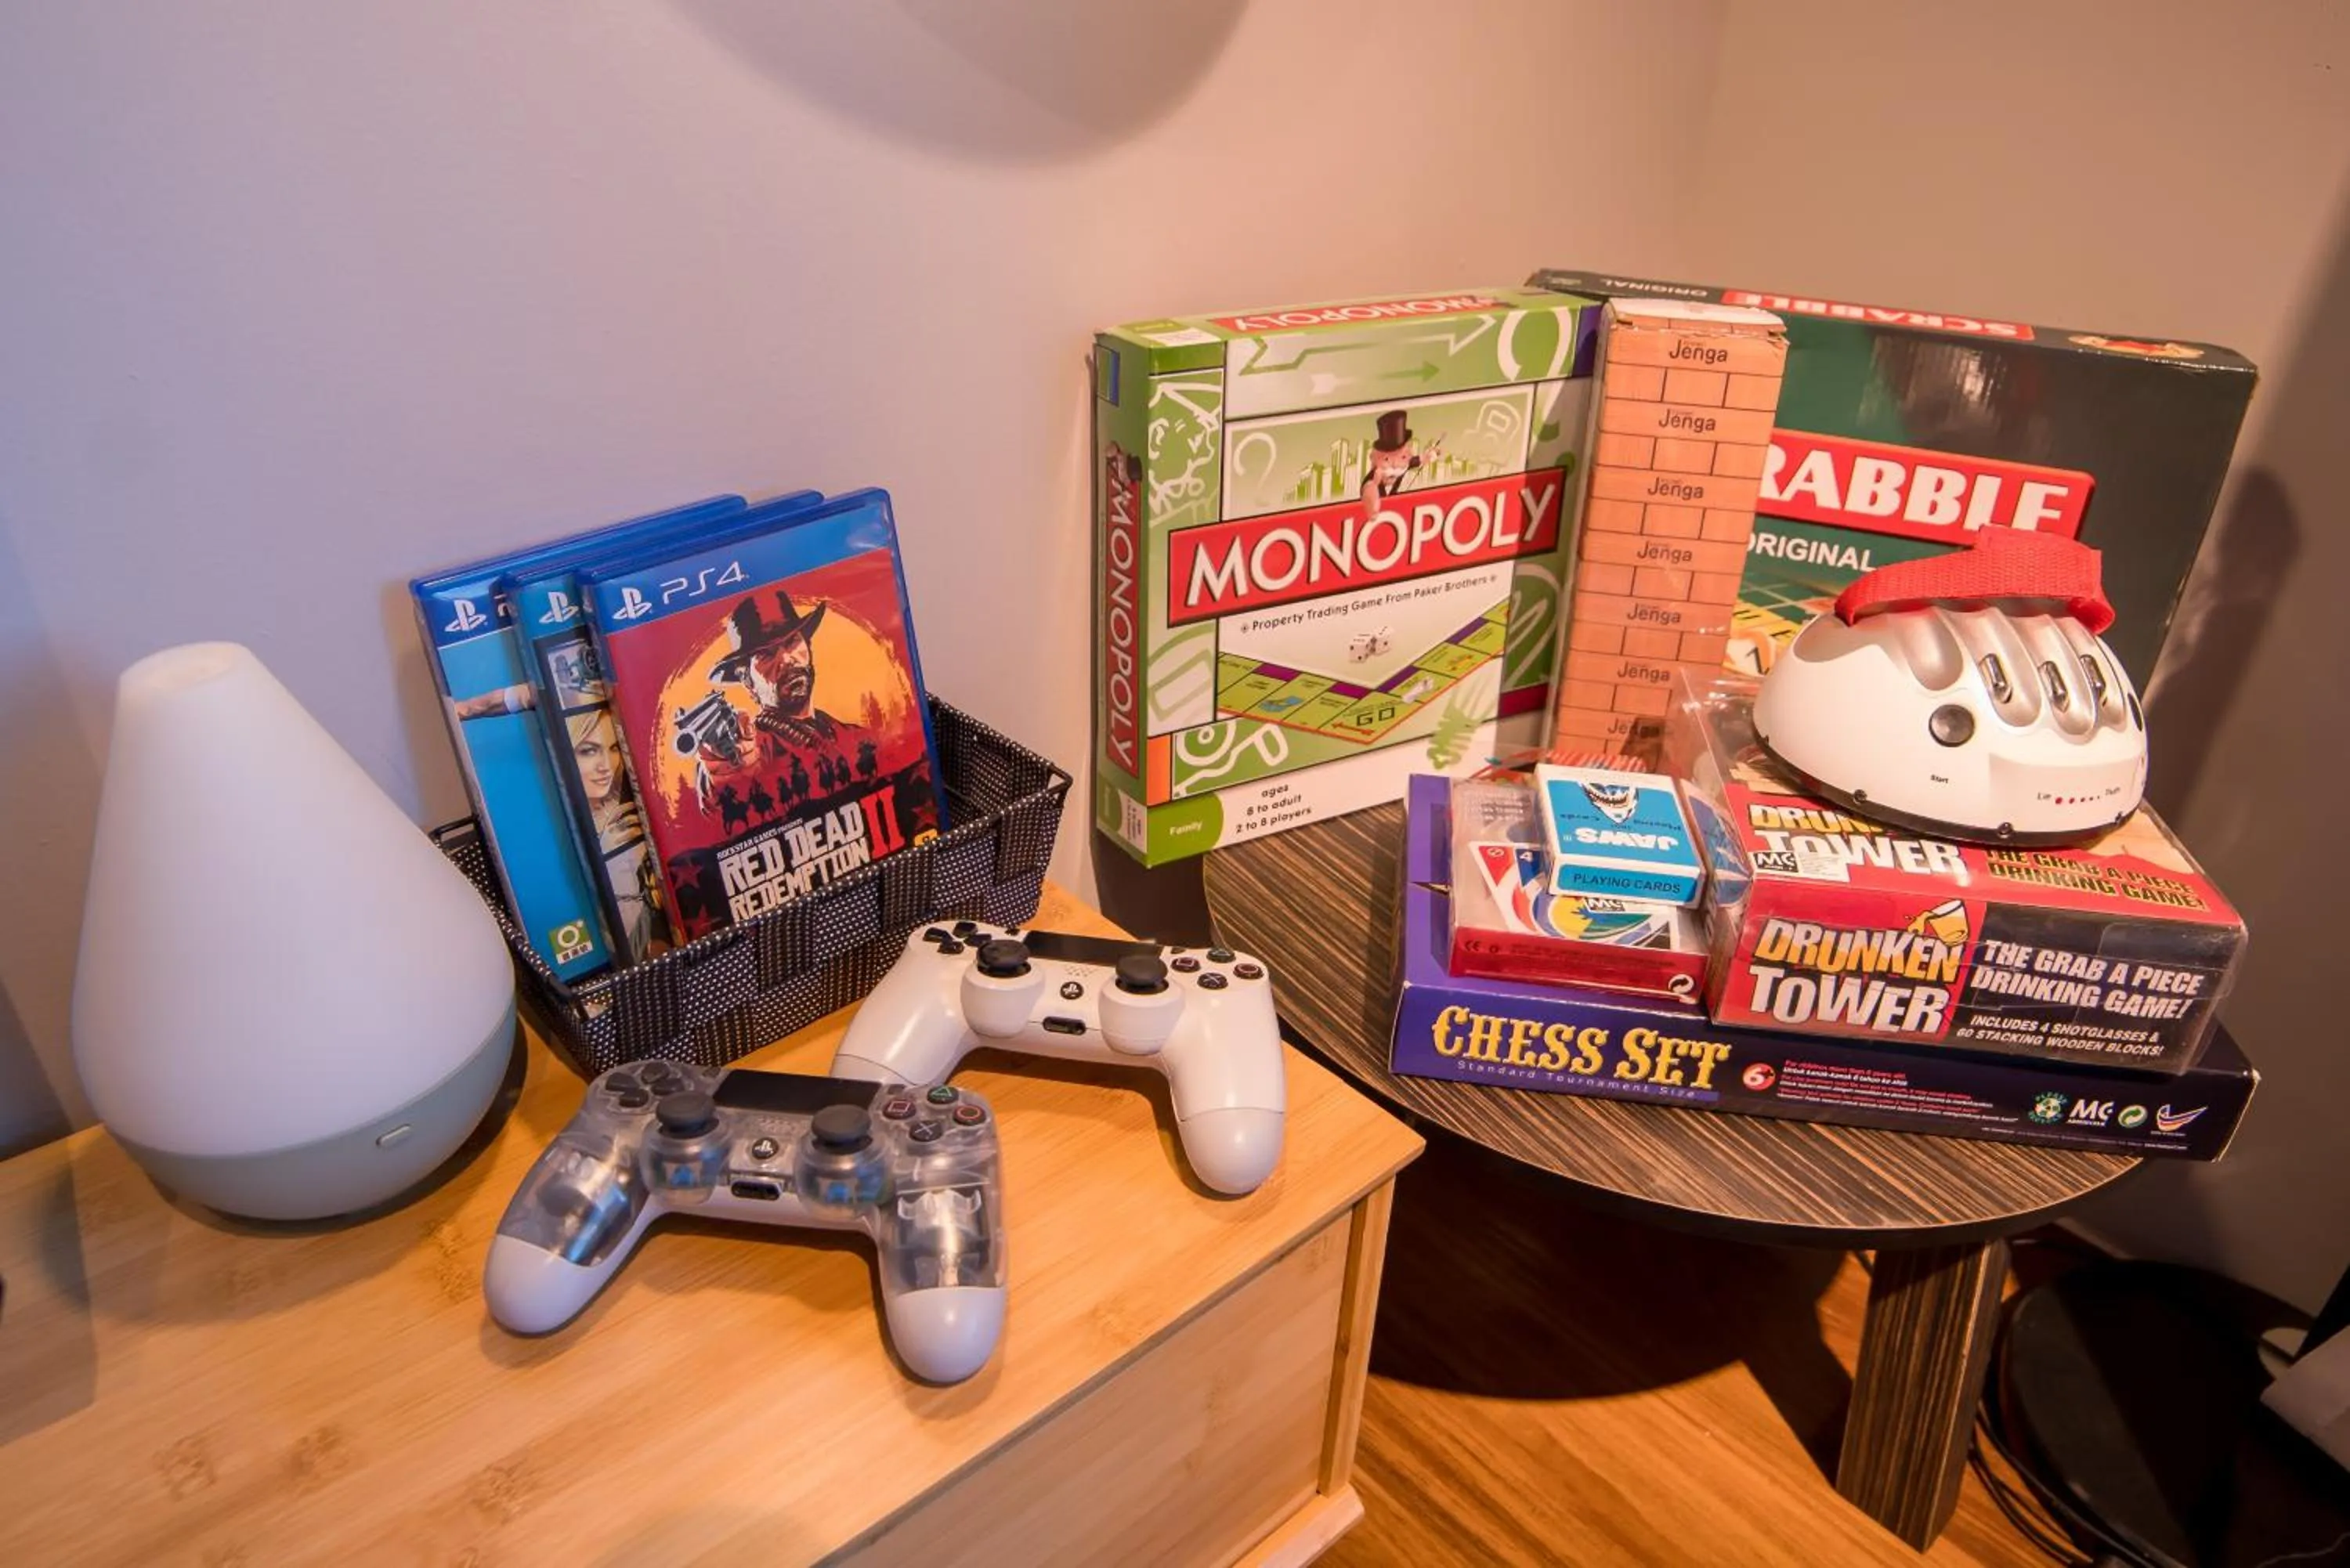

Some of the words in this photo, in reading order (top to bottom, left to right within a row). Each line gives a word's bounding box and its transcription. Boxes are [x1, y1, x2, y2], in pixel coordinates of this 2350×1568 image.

[1600, 279, 1708, 297] ORIGINAL
[1232, 296, 1487, 332] MONOPOLY
[1736, 293, 2018, 338] SCRABBLE
[1669, 340, 1728, 364] Jenga
[1658, 409, 1716, 432] Jenga
[1647, 477, 1705, 500] Jenga
[1185, 482, 1556, 607] MONOPOLY
[1636, 541, 1693, 562] Jenga
[660, 561, 746, 605] PS4
[1253, 612, 1304, 631] Property
[1307, 602, 1348, 620] Trading
[1351, 597, 1383, 612] Game
[1386, 591, 1411, 604] From
[1445, 576, 1488, 591] Brothers
[1627, 603, 1682, 624] Jenga
[1109, 478, 1134, 768] MONOPOLY
[1617, 662, 1671, 683] Jenga
[1356, 707, 1395, 727] GO
[1257, 803, 1268, 813] to
[1271, 795, 1302, 809] adult
[1262, 785, 1289, 798] ages
[1170, 821, 1202, 836] Family
[1236, 823, 1244, 833] 2
[1246, 820, 1257, 830] to
[1260, 817, 1267, 826] 8
[1270, 807, 1312, 826] players
[1748, 804, 1883, 833] DRUN
[718, 838, 785, 897] RED
[785, 801, 865, 868] DEAD
[1575, 827, 1679, 851] JAWS
[1520, 851, 1534, 862] 4
[1754, 829, 1971, 887] TOWER
[729, 836, 870, 923] REDEMPTION
[1573, 873, 1632, 889] PLAYING
[1634, 876, 1682, 894] CARDS
[1985, 851, 2028, 863] THE
[2033, 852, 2101, 878] GRAB
[2106, 866, 2124, 880] A
[2127, 870, 2195, 894] PIECE
[1988, 863, 2118, 896] DRINKING
[2121, 882, 2209, 912] GAME!
[1754, 918, 1964, 983] DRUNKEN
[1983, 939, 2033, 968] THE
[2034, 948, 2108, 981] GRAB
[2108, 963, 2129, 985] A
[2131, 965, 2204, 995] PIECE
[1749, 965, 1950, 1034] TOWER
[1970, 966, 2102, 1008] DRINKING
[2103, 989, 2194, 1020] GAME!
[1970, 1014, 2039, 1032] INCLUDES
[2039, 1023, 2049, 1033] 4
[2052, 1024, 2147, 1042] SHOTGLASSES
[2149, 1032, 2160, 1042] &
[1432, 1006, 1610, 1075] CHESS
[1614, 1027, 1732, 1089] SET
[1977, 1030, 2044, 1046] STACKING
[2045, 1036, 2106, 1052] WOODEN
[2106, 1042, 2165, 1056] BLOCKS!
[1457, 1060, 1535, 1079] Standard
[1546, 1073, 1649, 1093] Tournament
[1660, 1086, 1697, 1098] Size
